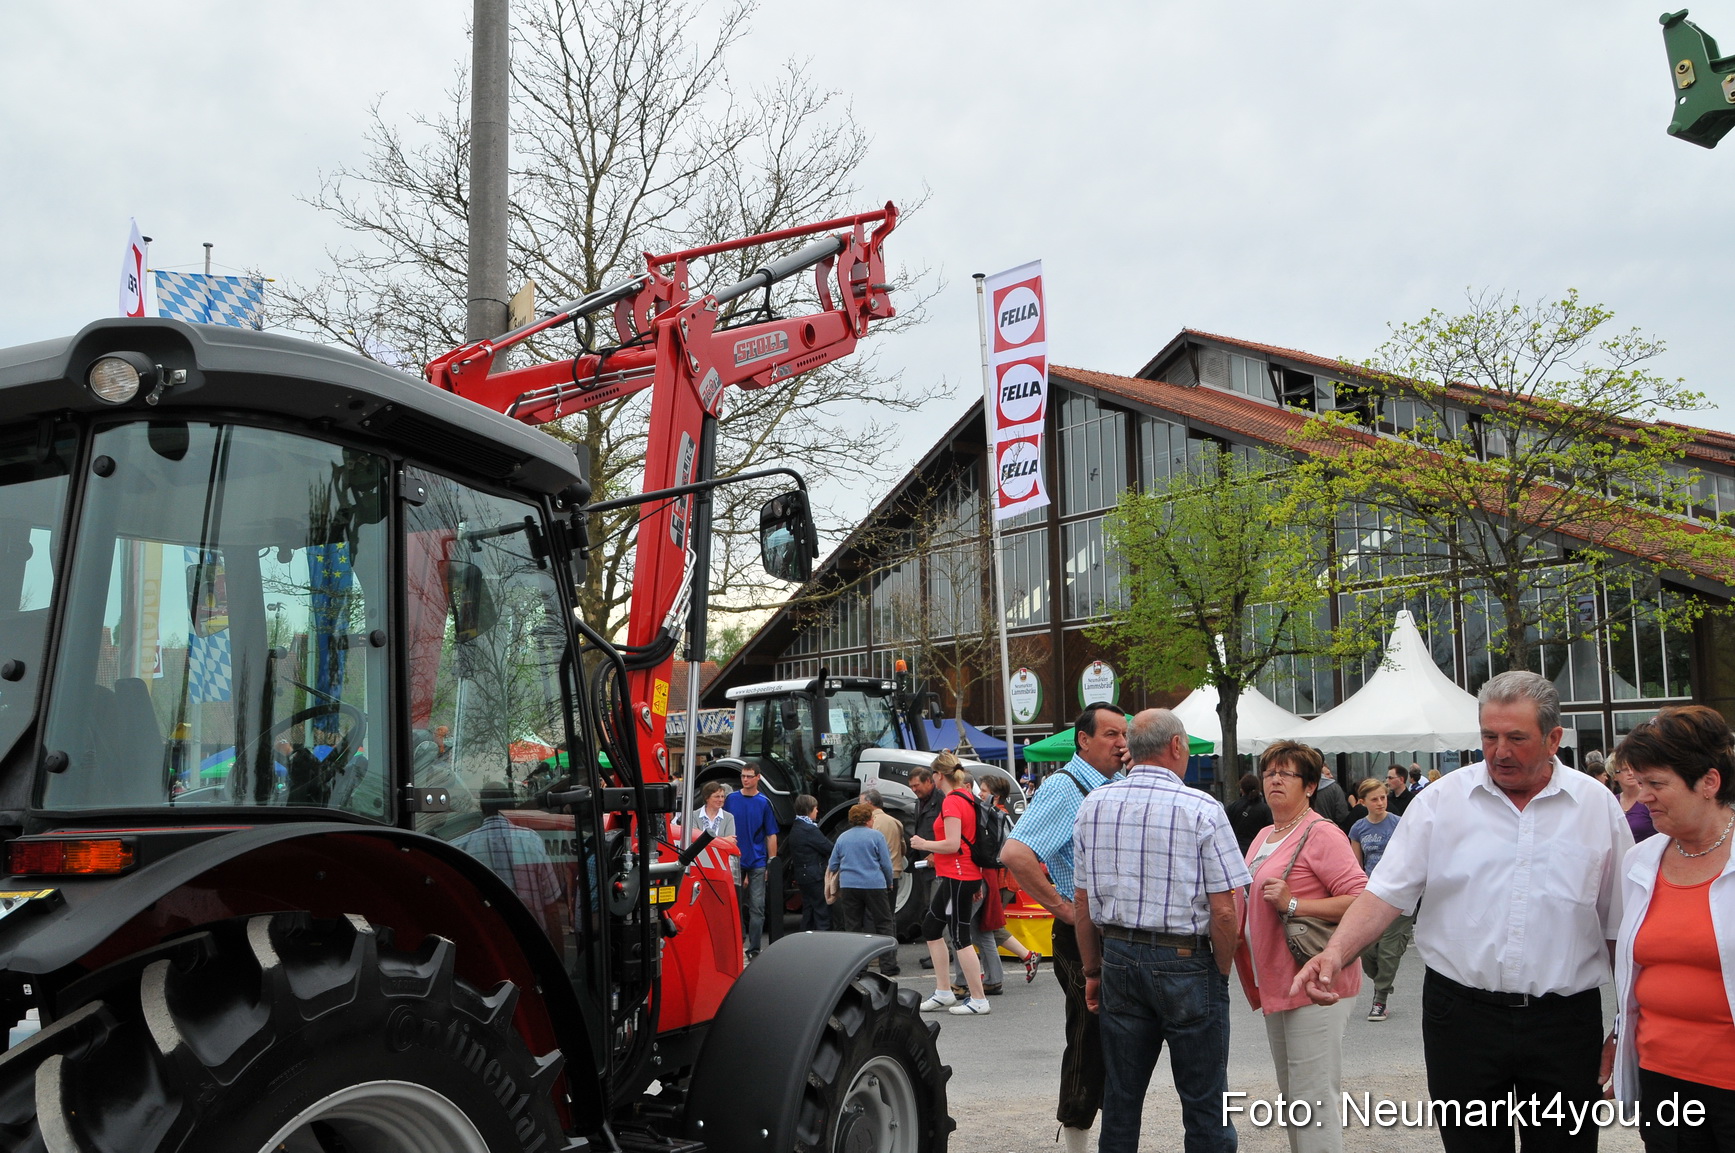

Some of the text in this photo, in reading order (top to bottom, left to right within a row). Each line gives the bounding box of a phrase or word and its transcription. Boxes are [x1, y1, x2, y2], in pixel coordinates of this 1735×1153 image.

[1000, 302, 1039, 328] FELLA
[736, 333, 785, 362] STOLL
[1001, 380, 1042, 404] FELLA
[1001, 459, 1038, 481] FELLA
[1011, 688, 1037, 696] Lammsbräu
[1084, 682, 1112, 690] Lammsbräu
[385, 1003, 549, 1153] Continental
